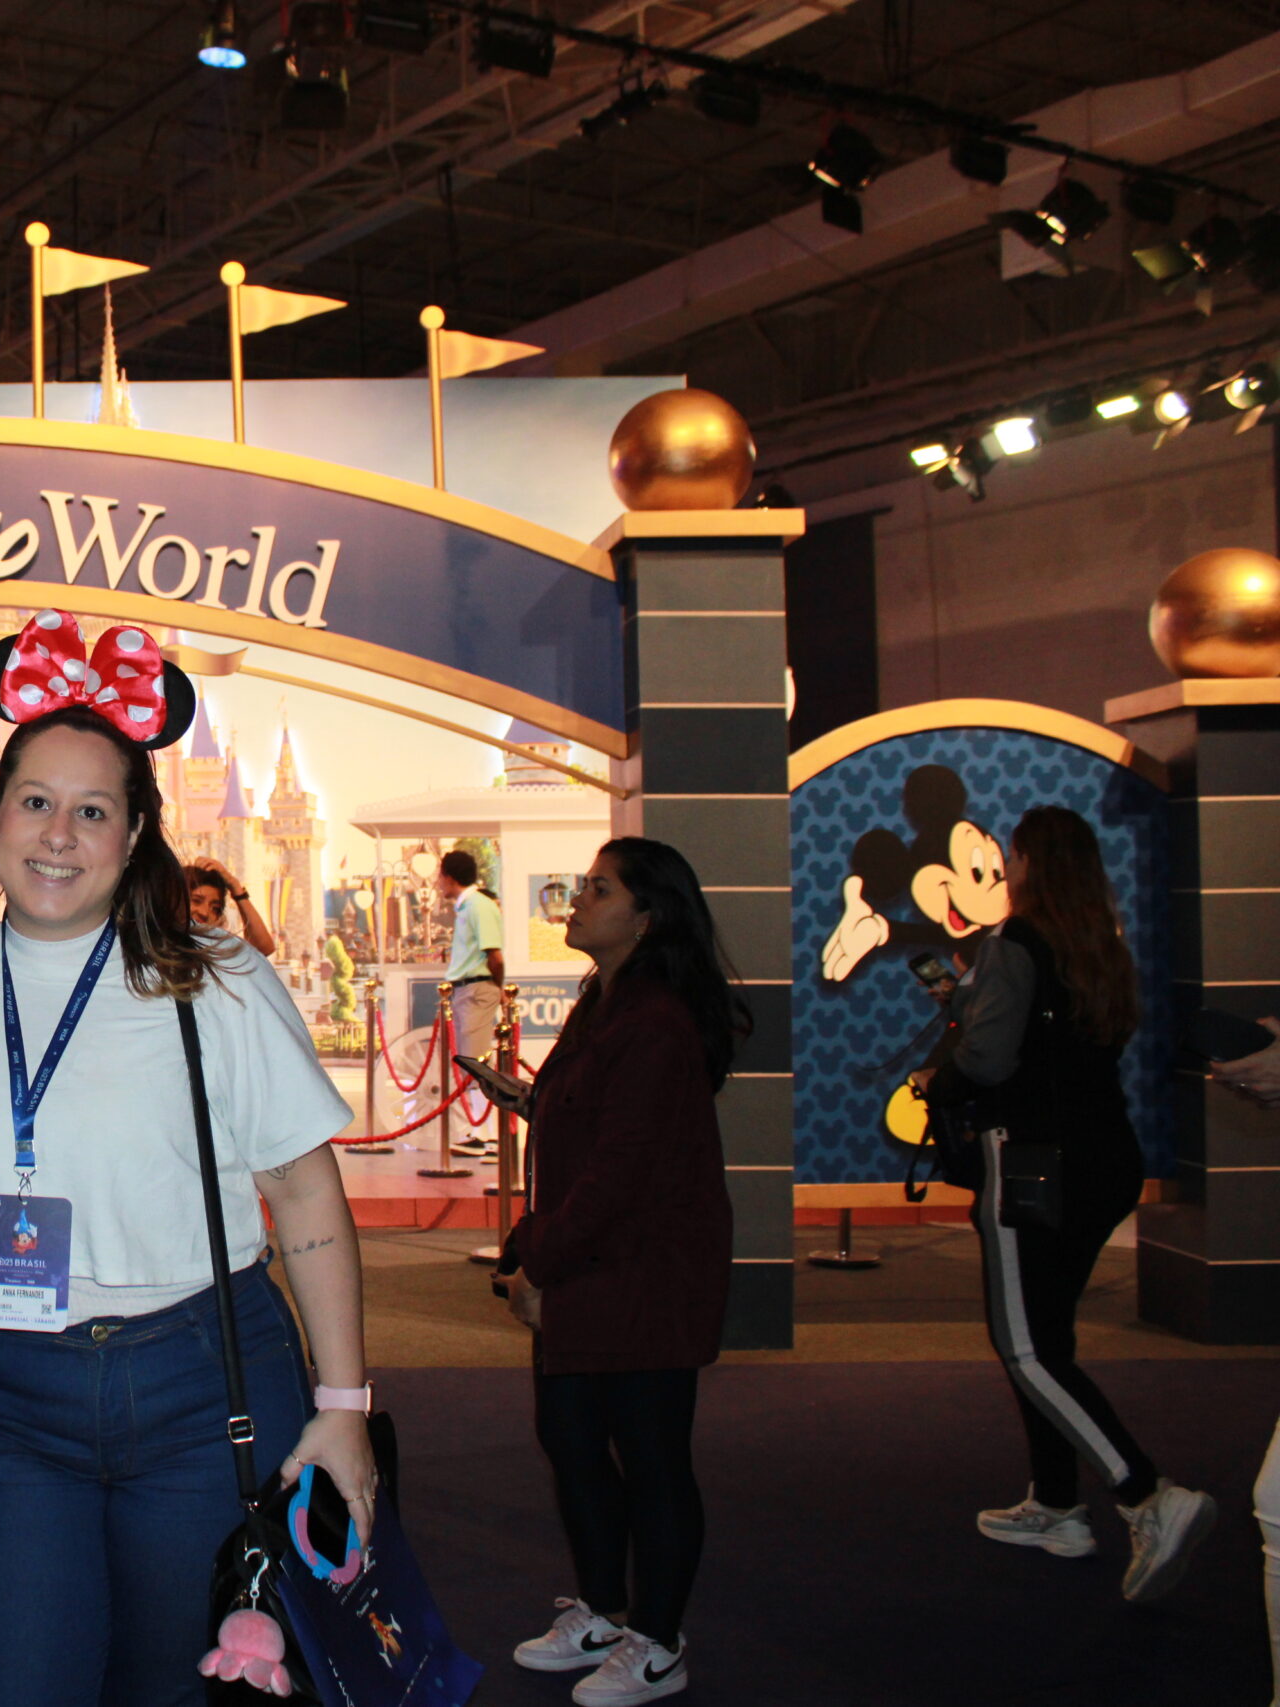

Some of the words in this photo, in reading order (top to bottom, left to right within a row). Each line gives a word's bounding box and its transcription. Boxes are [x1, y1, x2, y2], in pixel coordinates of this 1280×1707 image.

[40, 490, 340, 628] World
[92, 940, 110, 967] BRASIL
[14, 1258, 47, 1269] BRASIL
